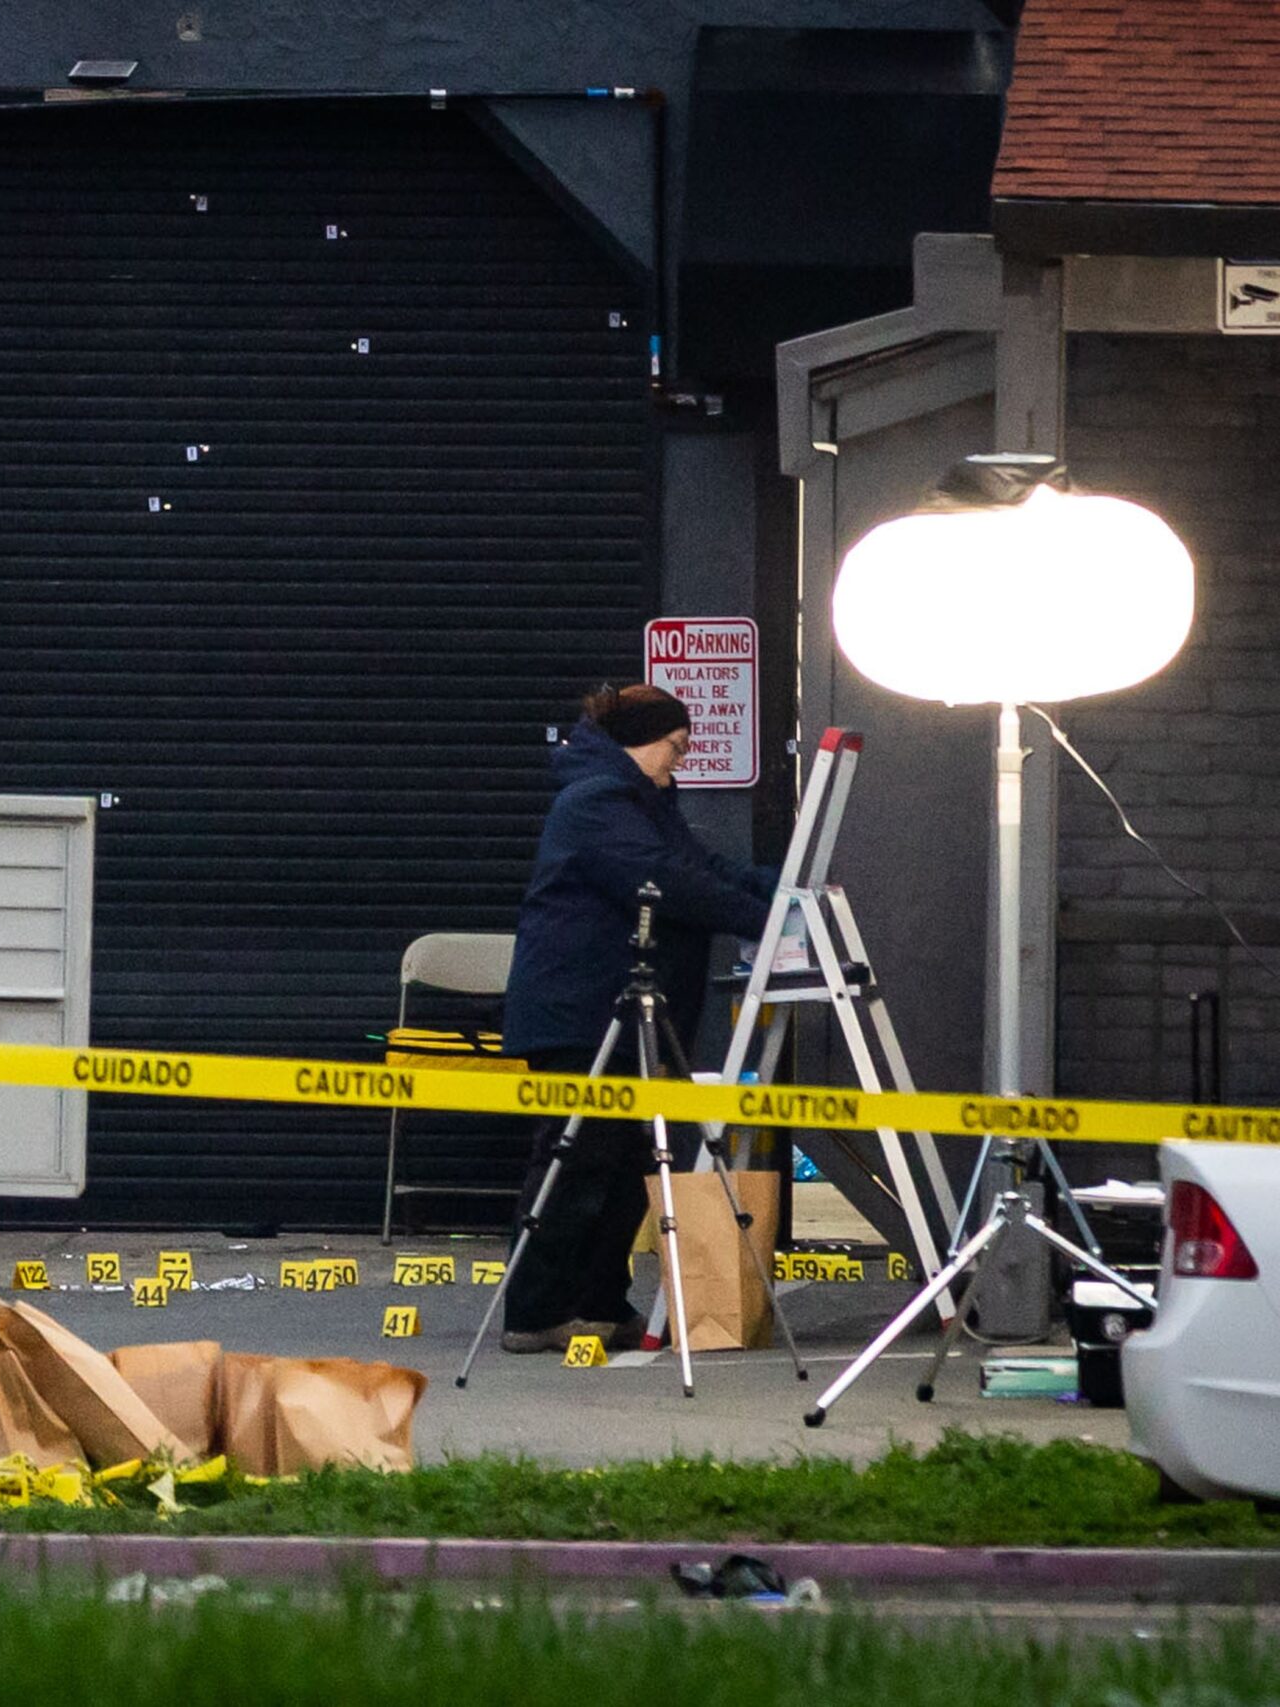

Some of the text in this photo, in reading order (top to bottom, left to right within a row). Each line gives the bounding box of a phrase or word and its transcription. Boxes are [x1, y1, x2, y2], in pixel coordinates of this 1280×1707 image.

[651, 630, 750, 658] NO PARKING
[665, 667, 740, 681] VIOLATORS
[675, 685, 729, 699] WILL BE
[709, 704, 746, 717] AWAY
[691, 721, 741, 735] EHICLE
[687, 740, 733, 753] NER'S
[74, 1056, 192, 1087] CUIDADO
[296, 1068, 414, 1099] CAUTION
[518, 1080, 635, 1112] CUIDADO
[740, 1092, 858, 1122] CAUTION
[961, 1101, 1080, 1133] CUIDADO
[91, 1260, 118, 1281] 52
[162, 1270, 188, 1291] 57
[305, 1269, 332, 1290] 47
[136, 1285, 164, 1305] 44
[385, 1313, 412, 1334] 41
[567, 1343, 592, 1365] 36
